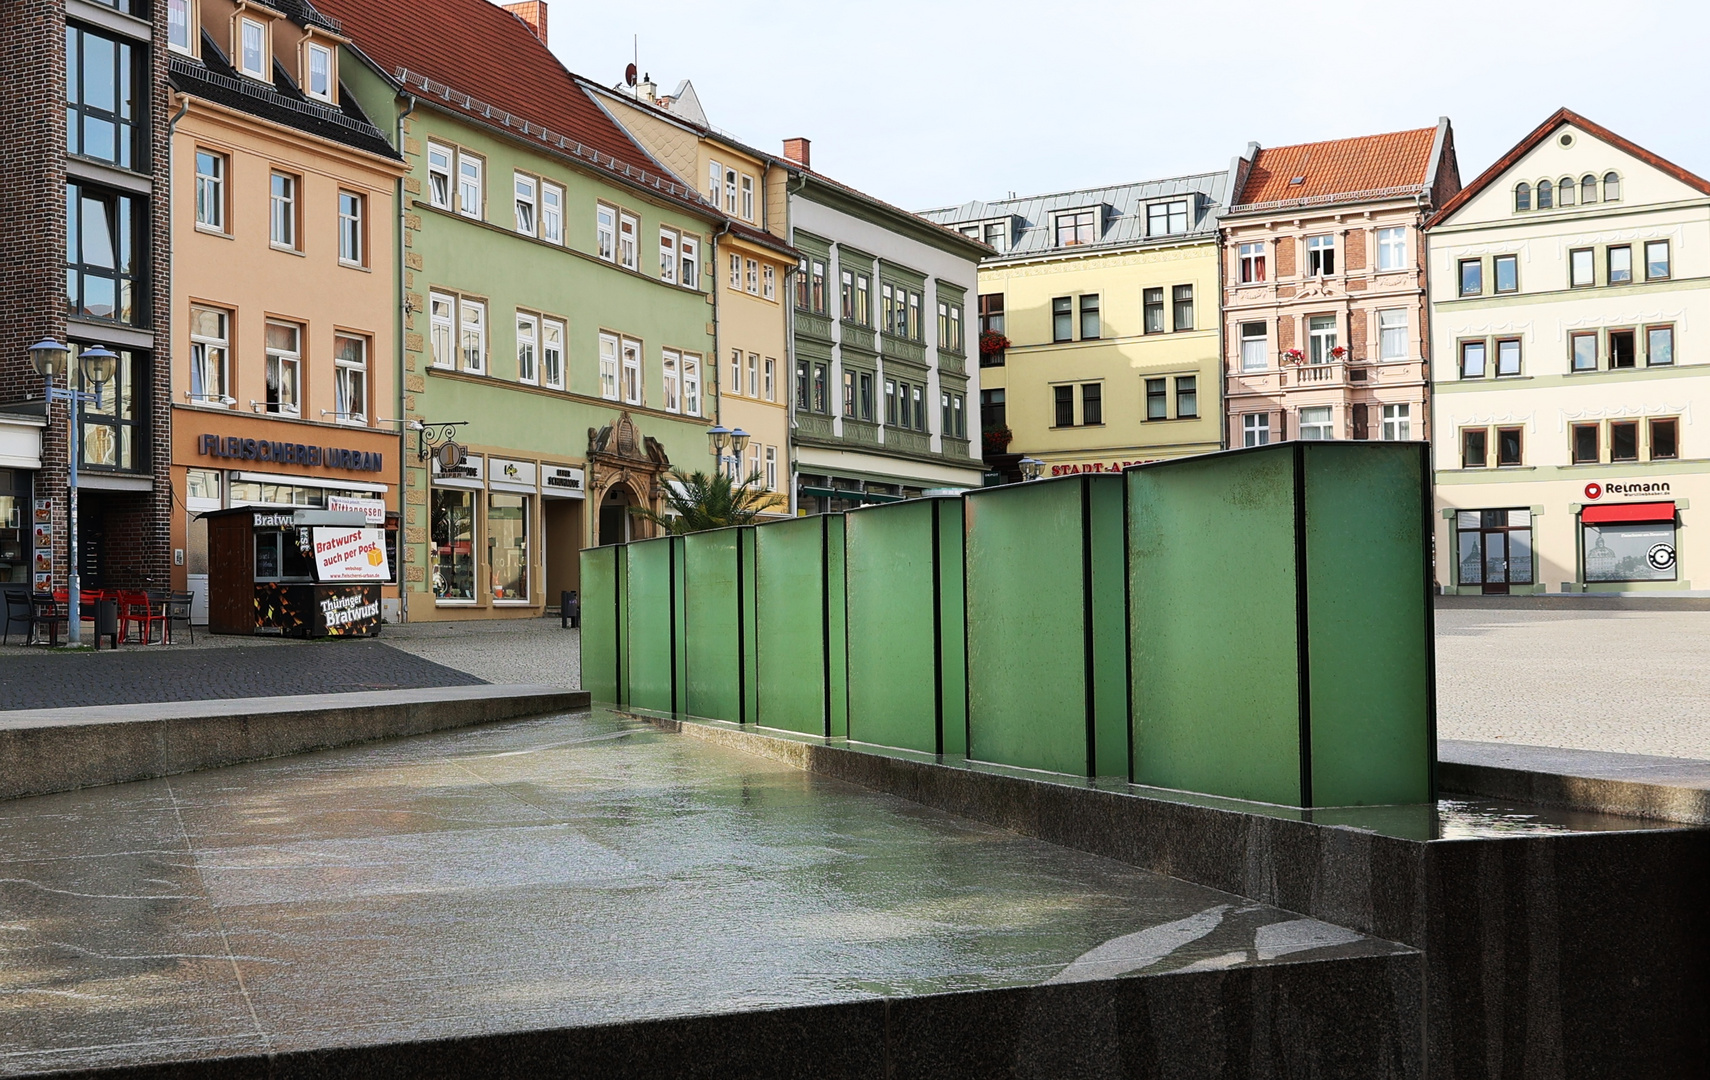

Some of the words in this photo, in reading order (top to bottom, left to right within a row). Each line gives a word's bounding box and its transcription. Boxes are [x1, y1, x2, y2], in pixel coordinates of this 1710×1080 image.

[198, 433, 322, 467] FLEISCHEREI
[324, 447, 382, 472] URBAN
[1605, 482, 1670, 493] Reimann
[316, 530, 362, 554] Bratwurst
[323, 552, 343, 567] auch
[344, 548, 357, 562] per
[358, 541, 376, 553] Post
[320, 593, 362, 612] Thüringer
[325, 600, 379, 627] Bratwurst
